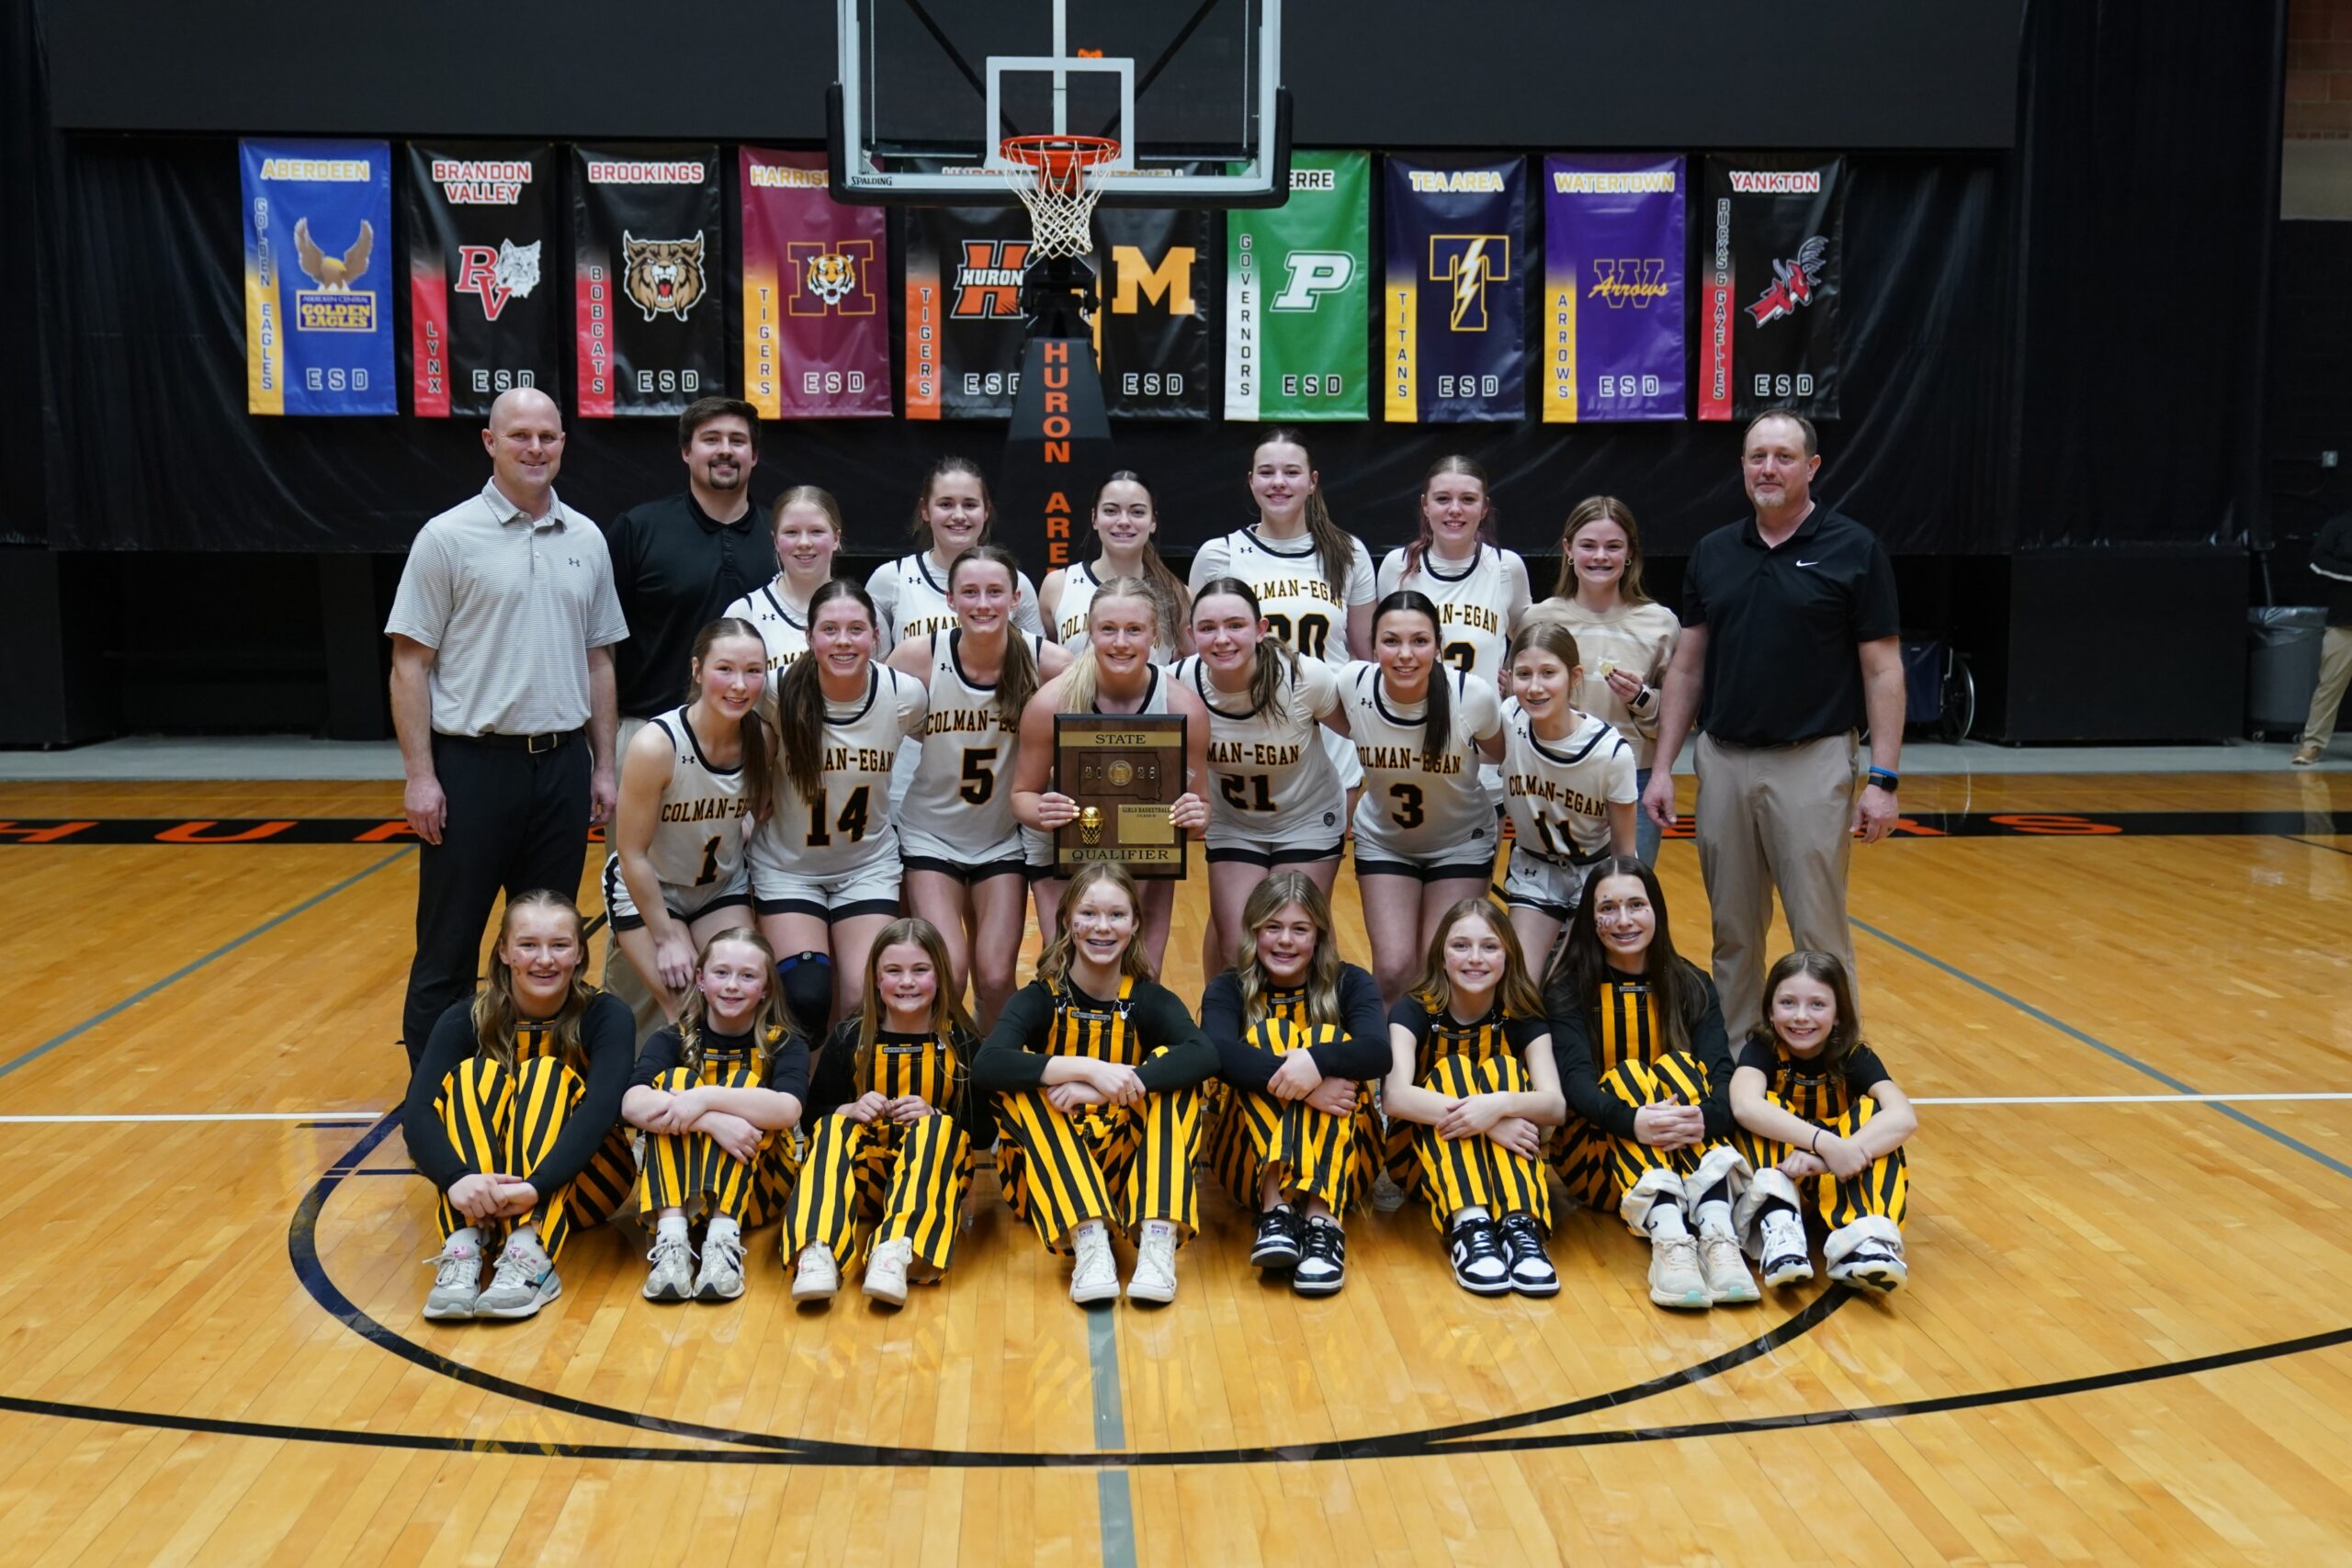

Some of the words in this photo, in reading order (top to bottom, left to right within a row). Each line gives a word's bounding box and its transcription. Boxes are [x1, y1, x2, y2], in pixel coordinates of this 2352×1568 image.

[261, 159, 370, 181] ABERDEEN
[433, 161, 532, 183] BRANDON
[588, 162, 704, 184] BROOKINGS
[750, 164, 829, 187] HARRIS
[851, 175, 892, 186] SPALDING
[1289, 170, 1334, 190] ERRE
[1409, 172, 1447, 191] TEA
[1449, 172, 1504, 191] AREA
[1729, 172, 1820, 192] YANKTON
[445, 184, 522, 204] VALLEY
[1554, 172, 1675, 193] WATERTOWN
[1715, 198, 1730, 269] BUCKS
[961, 269, 1023, 287] HURON
[1588, 275, 1668, 299] Arrows
[301, 303, 370, 316] GOLDEN
[305, 315, 368, 328] EAGLES
[1239, 234, 1252, 397] GOVERNORS
[590, 265, 605, 395] BOBCATS
[757, 288, 772, 396] TIGERS
[261, 303, 273, 391] EAGLES
[920, 288, 933, 397] TIGERS
[1397, 292, 1408, 398] TITANS
[1556, 293, 1570, 399] ARROWS
[1713, 289, 1727, 399] GAZELLES
[426, 321, 442, 393] LYNX
[307, 367, 370, 391] ESD
[638, 369, 699, 393] ESD
[804, 371, 865, 394] ESD
[1123, 373, 1183, 396] ESD
[1283, 374, 1341, 397] ESD
[1439, 375, 1498, 398] ESD
[1599, 375, 1659, 398] ESD
[1755, 374, 1814, 397] ESD
[1043, 342, 1071, 464] HURON
[1045, 491, 1071, 573] ARE
[1095, 734, 1147, 745] STATE
[824, 747, 894, 773] AN-EGAN
[1206, 741, 1299, 766] MAN-EGAN
[960, 747, 997, 806] 5
[806, 785, 870, 847] 14
[1389, 783, 1424, 829] 3
[1533, 810, 1589, 857] 11
[695, 835, 721, 886] 1
[1071, 850, 1170, 862] QUALIFIER
